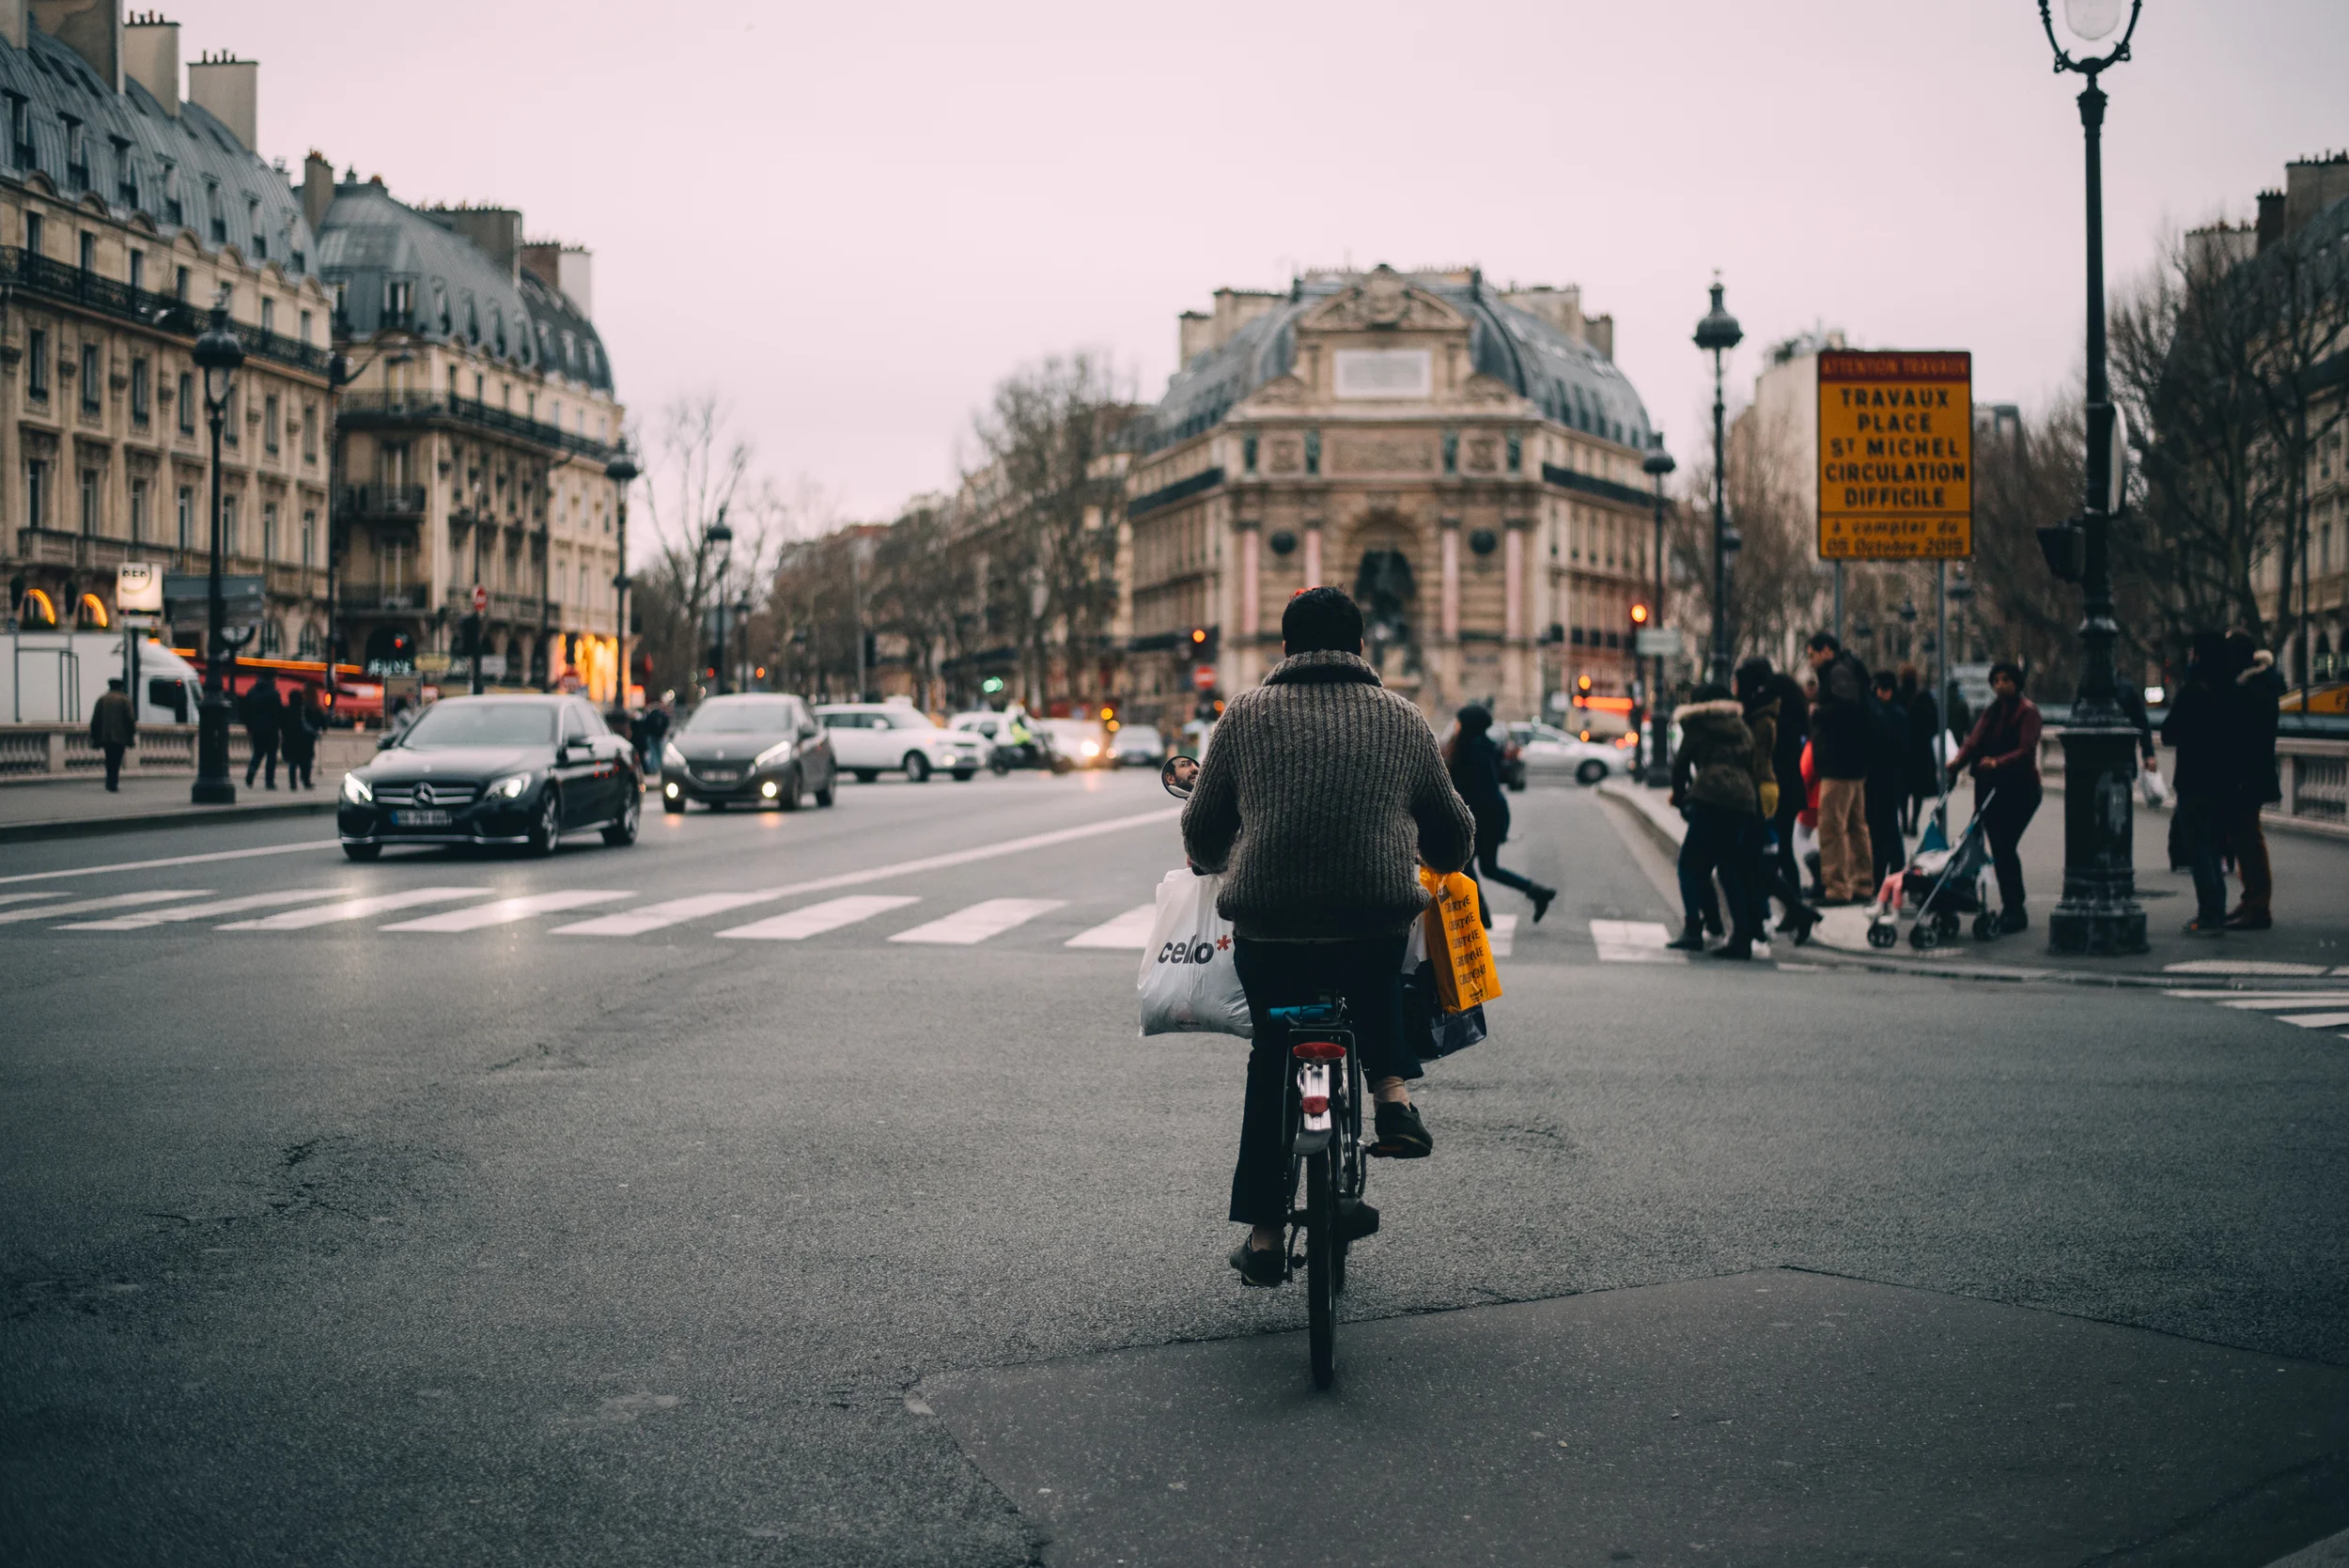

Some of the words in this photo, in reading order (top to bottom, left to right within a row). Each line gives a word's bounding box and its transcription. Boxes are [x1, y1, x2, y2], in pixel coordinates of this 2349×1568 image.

[1841, 388, 1950, 408] TRAVAUX
[1858, 412, 1933, 433] PLACE
[1867, 438, 1960, 458] MICHEL
[1826, 462, 1966, 483] CIRCULATION
[1844, 487, 1946, 507] DIFFICILE
